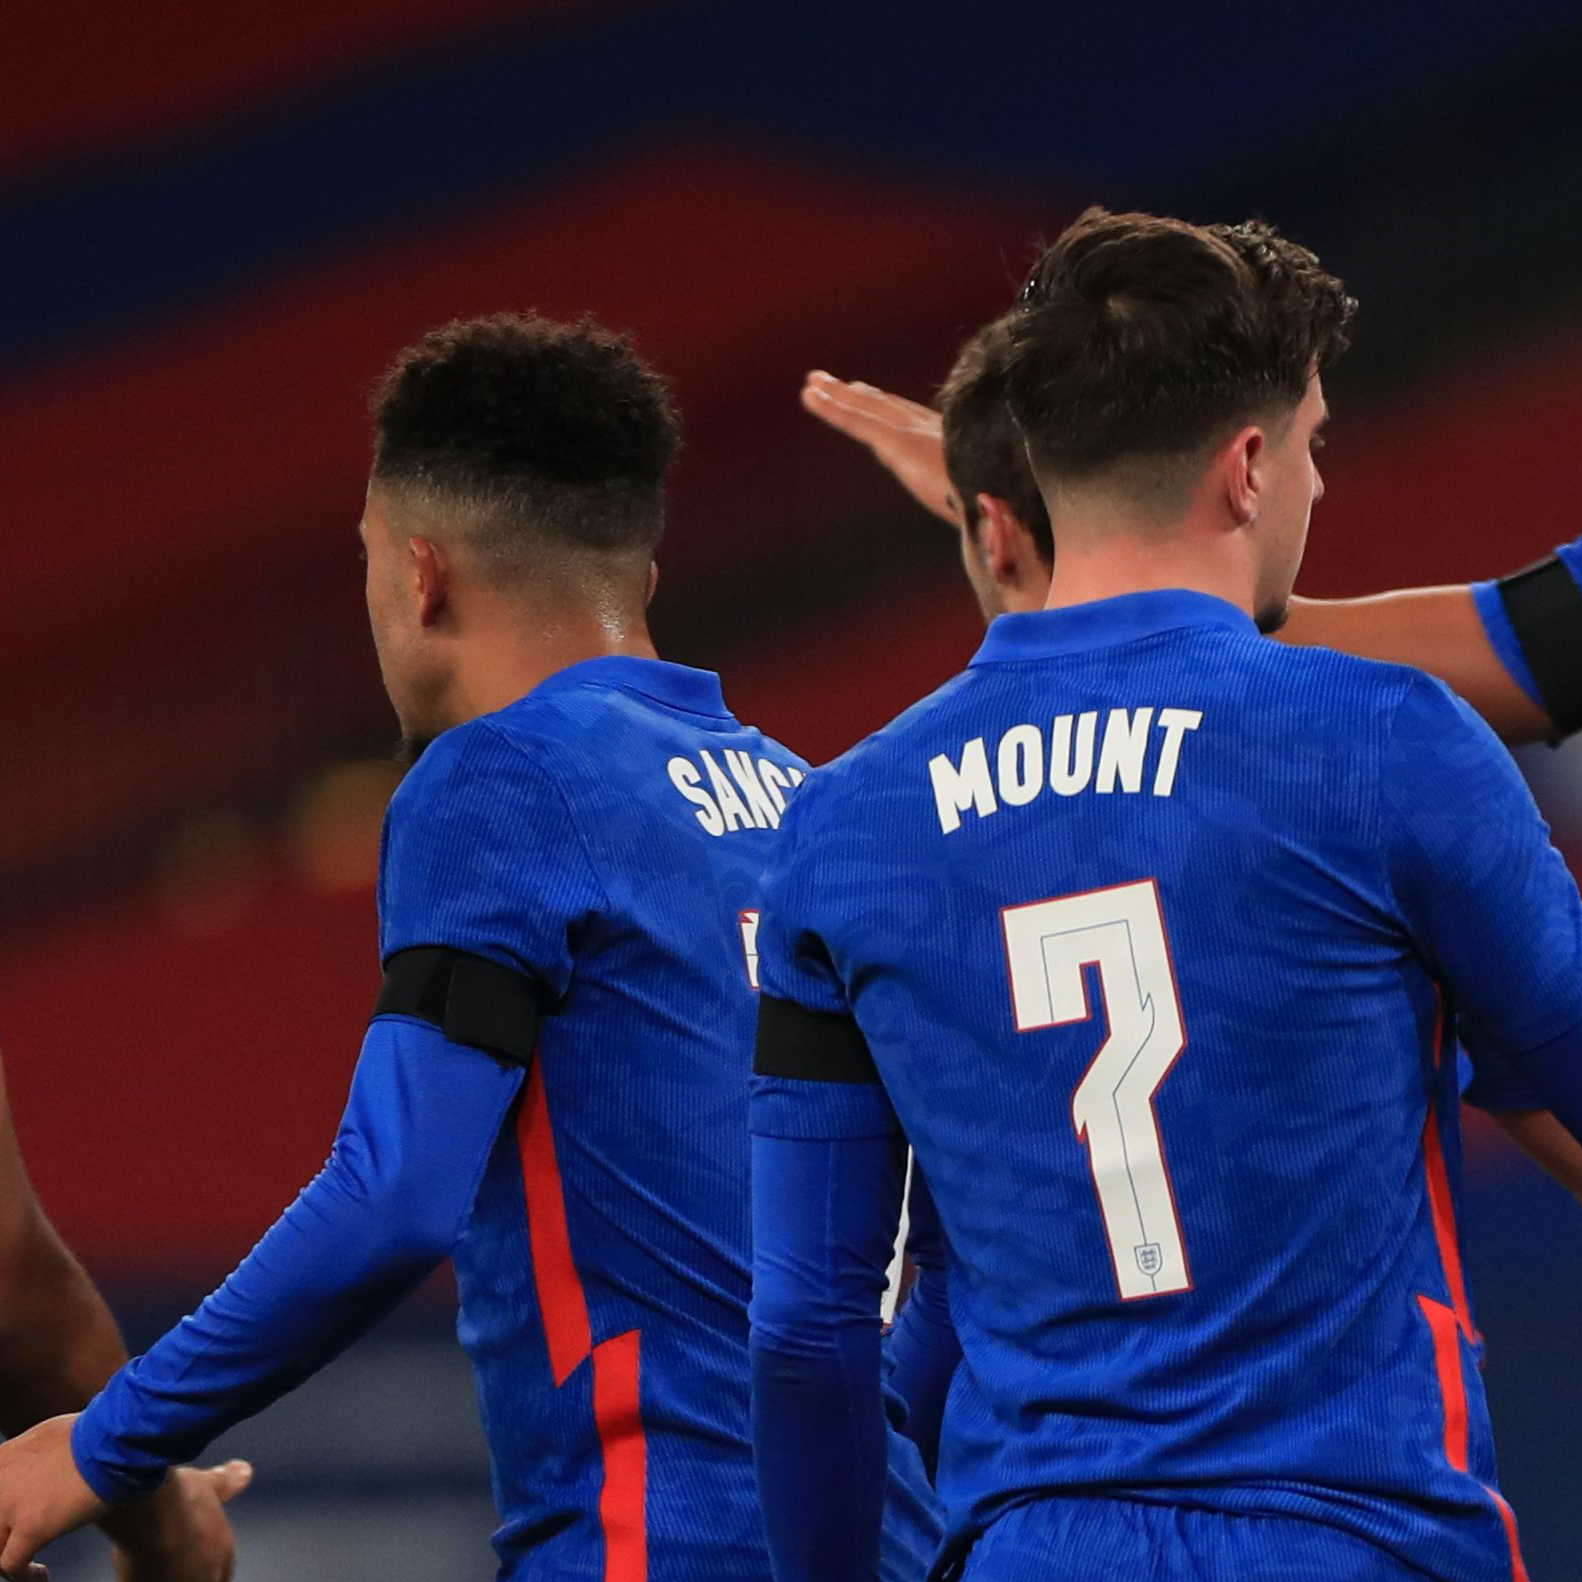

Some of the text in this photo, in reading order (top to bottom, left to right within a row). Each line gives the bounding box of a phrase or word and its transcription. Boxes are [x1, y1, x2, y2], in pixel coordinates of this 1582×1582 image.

[667, 749, 806, 837] SANC
[928, 707, 1203, 835] MOUNT
[1000, 878, 1192, 1301] 7
